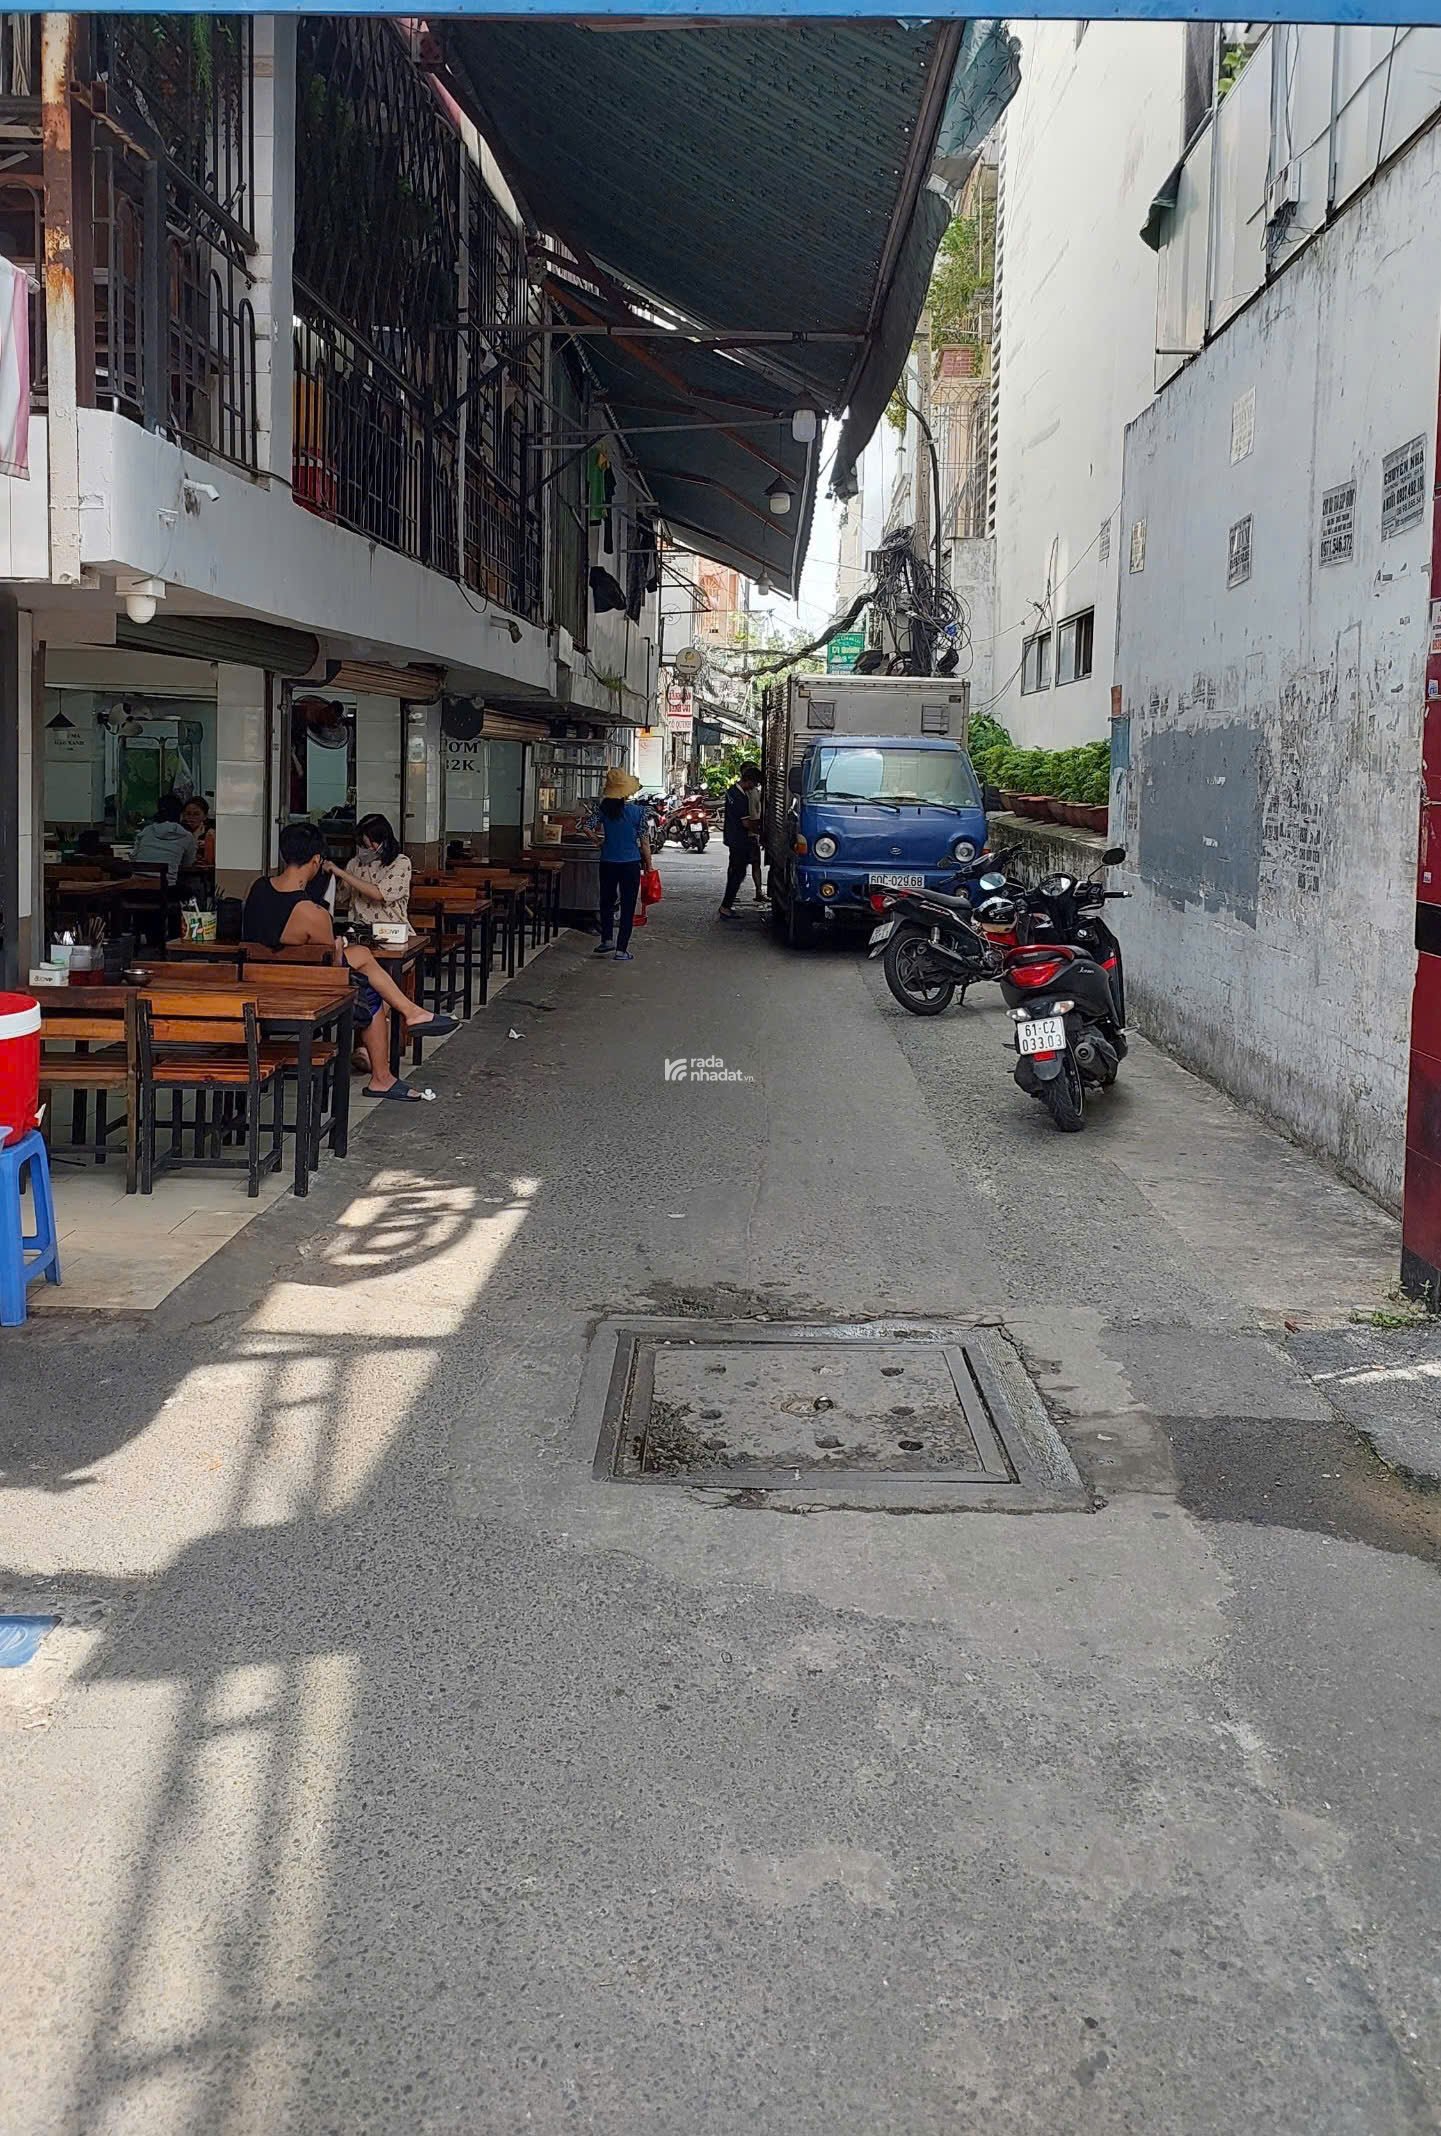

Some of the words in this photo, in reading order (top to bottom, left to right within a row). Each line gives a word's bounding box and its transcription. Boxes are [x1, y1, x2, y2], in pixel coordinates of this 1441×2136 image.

[446, 741, 478, 753] ƠM
[1025, 1021, 1056, 1037] 61-C2
[1022, 1034, 1062, 1052] 033.03
